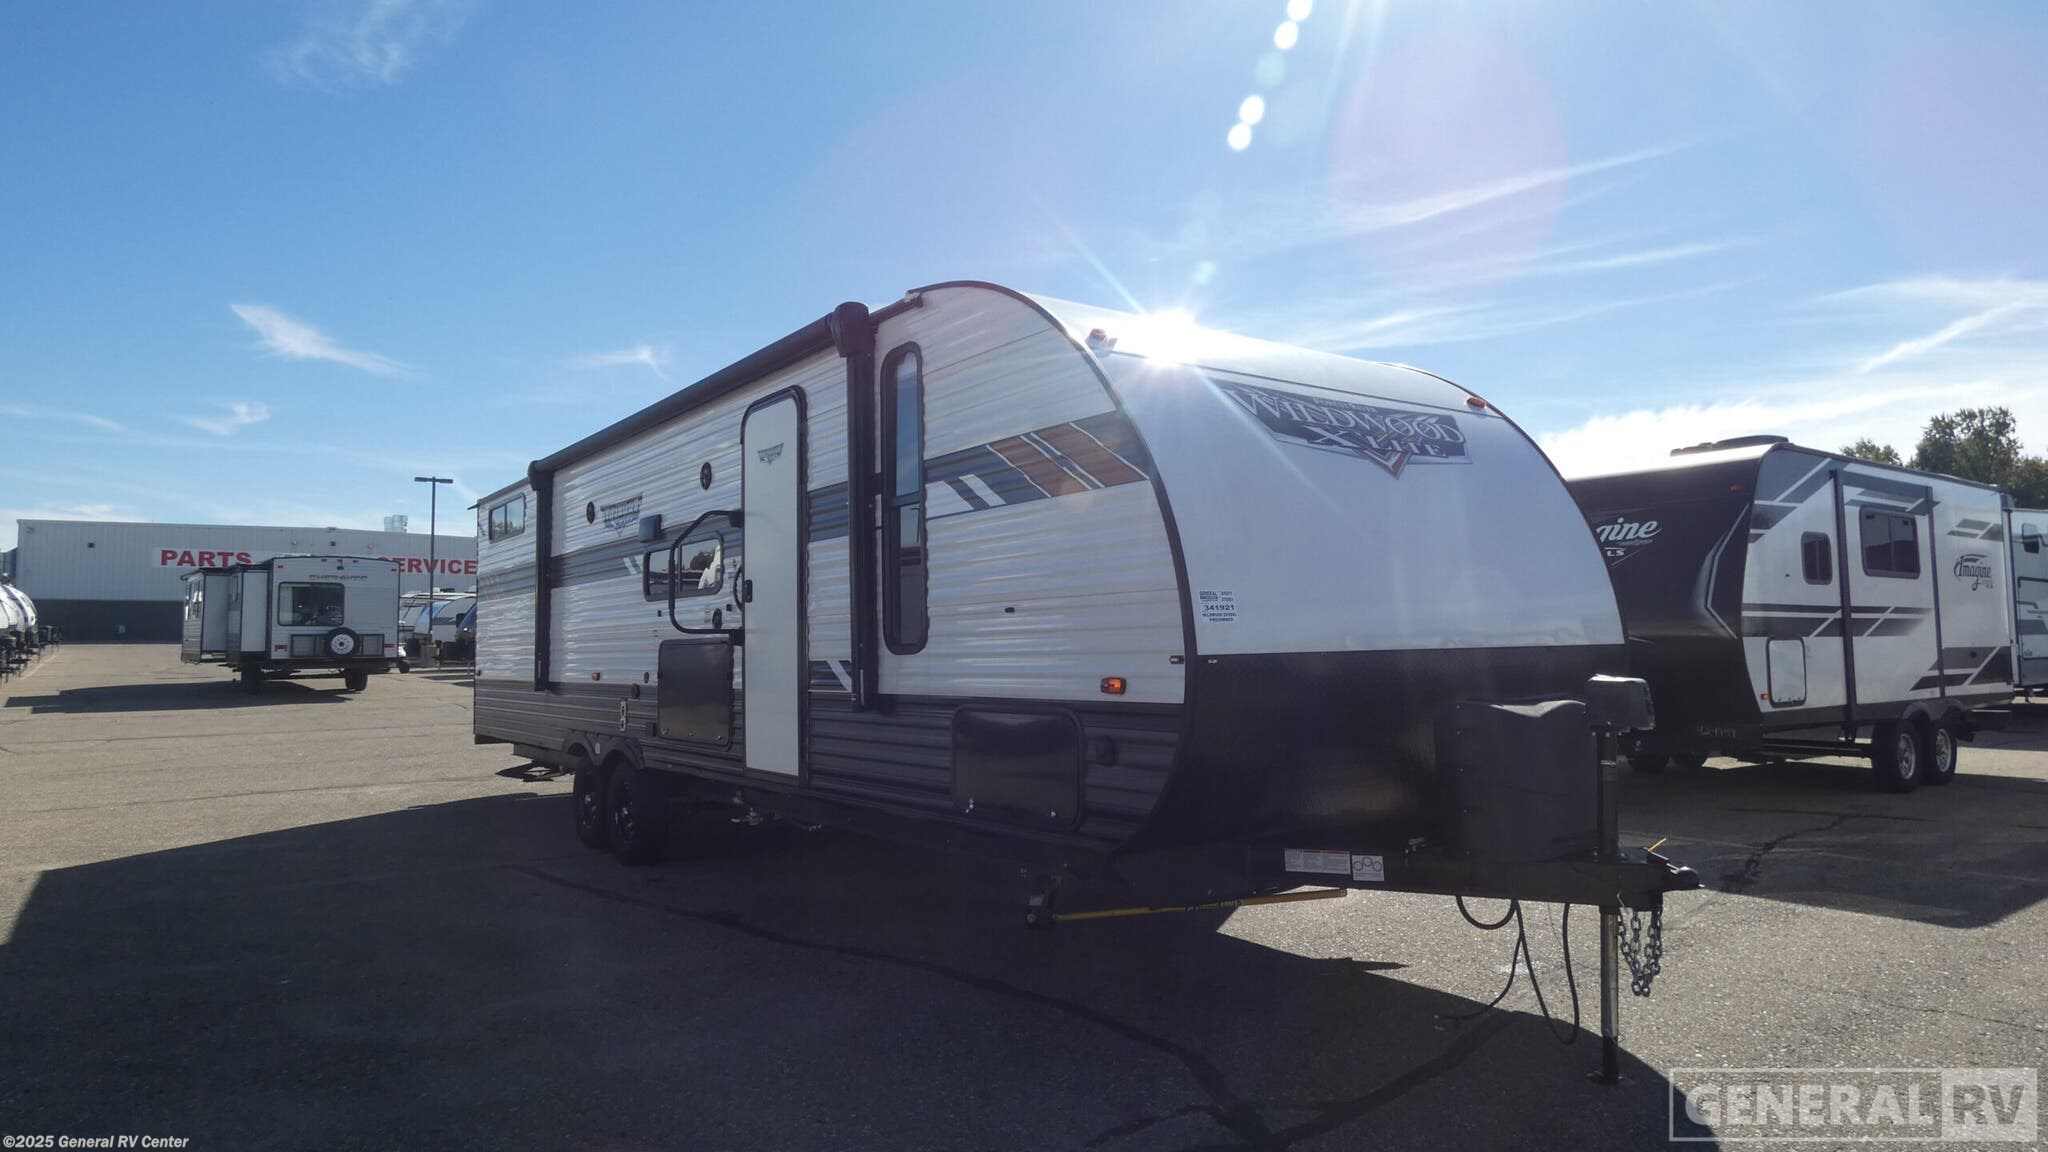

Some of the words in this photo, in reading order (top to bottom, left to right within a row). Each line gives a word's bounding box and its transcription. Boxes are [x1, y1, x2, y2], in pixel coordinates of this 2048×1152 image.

[1223, 388, 1466, 444] WILDWOOD
[161, 549, 253, 569] PARTS
[377, 556, 479, 575] ERVICE
[1955, 555, 1992, 591] Imagine
